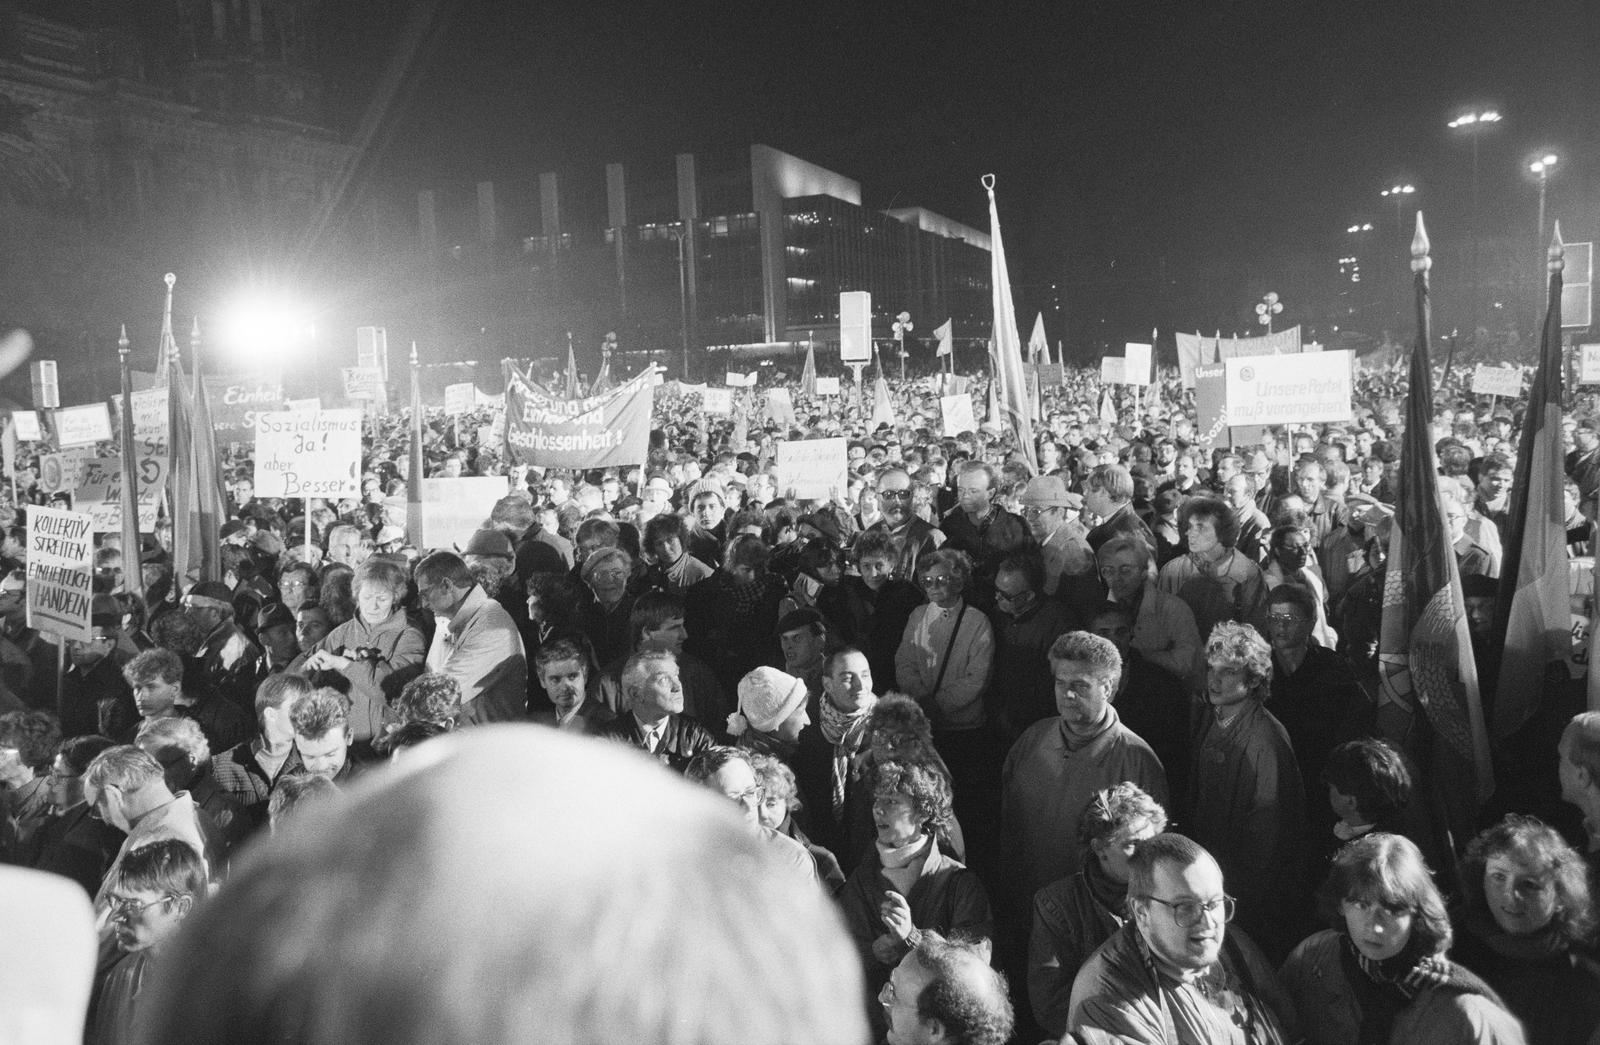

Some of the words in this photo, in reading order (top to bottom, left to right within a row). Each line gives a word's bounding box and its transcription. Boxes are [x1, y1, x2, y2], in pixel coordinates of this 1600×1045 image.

[224, 385, 285, 405] Einheit
[1256, 381, 1307, 397] Unsere
[1309, 377, 1342, 394] Partei
[1234, 401, 1264, 420] muß
[261, 412, 358, 433] Sozialismus
[1200, 404, 1228, 445] Sozial
[144, 437, 169, 456] SE
[264, 452, 293, 471] aber
[83, 464, 107, 487] Für
[33, 514, 90, 539] KOLLEKTIV
[29, 559, 91, 591] EINHEITLICH
[35, 582, 90, 621] HANDELN
